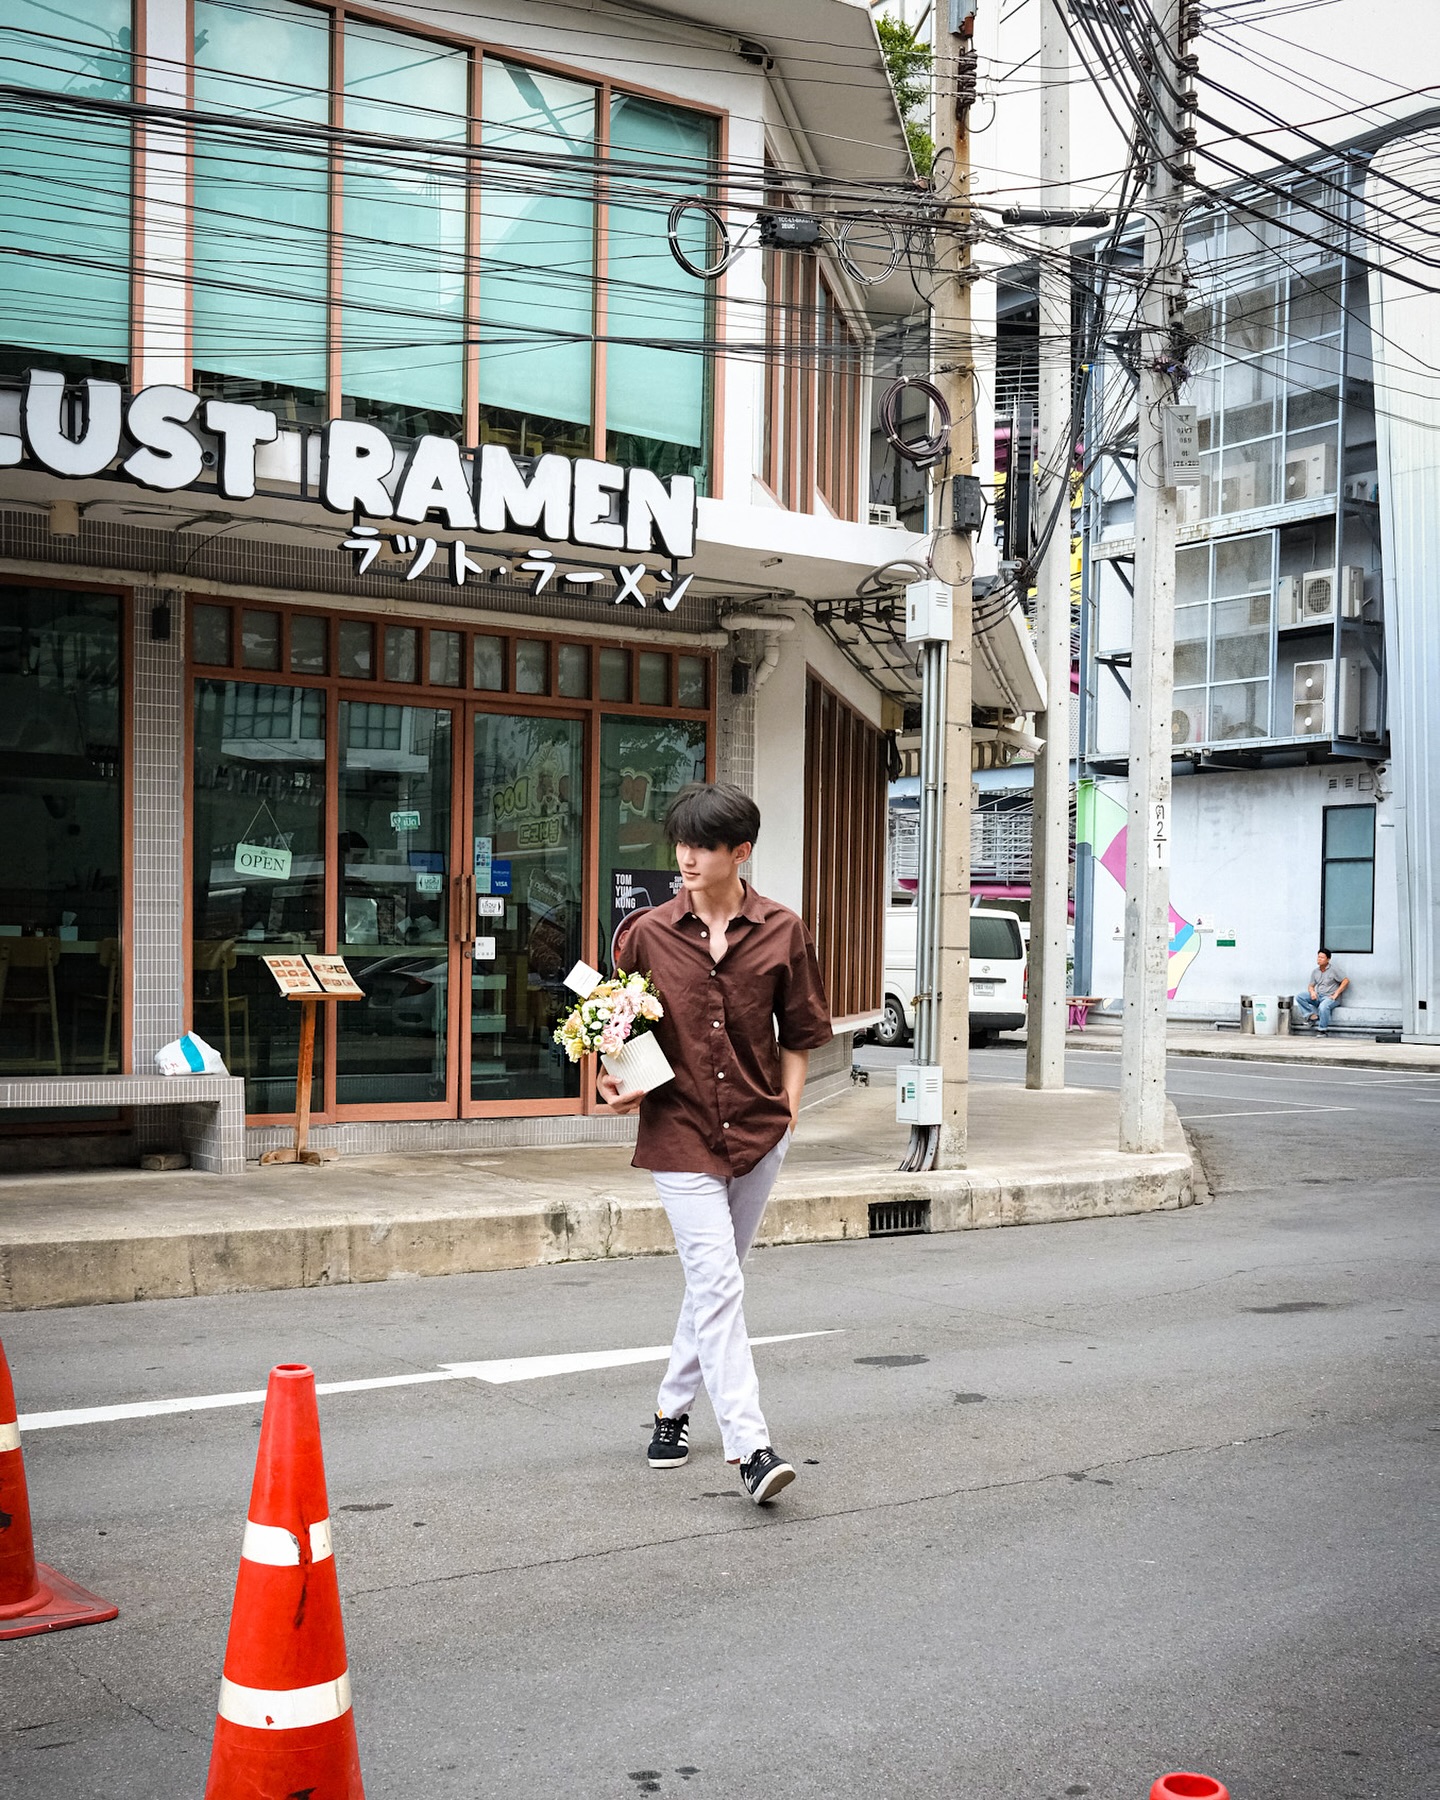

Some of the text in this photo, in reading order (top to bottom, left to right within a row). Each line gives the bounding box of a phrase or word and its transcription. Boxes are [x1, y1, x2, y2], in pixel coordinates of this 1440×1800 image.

[318, 417, 698, 560] RAMEN
[1156, 821, 1164, 837] 2
[1156, 843, 1162, 859] 1
[240, 853, 286, 872] OPEN
[615, 874, 632, 885] TOM
[615, 886, 632, 897] YUM
